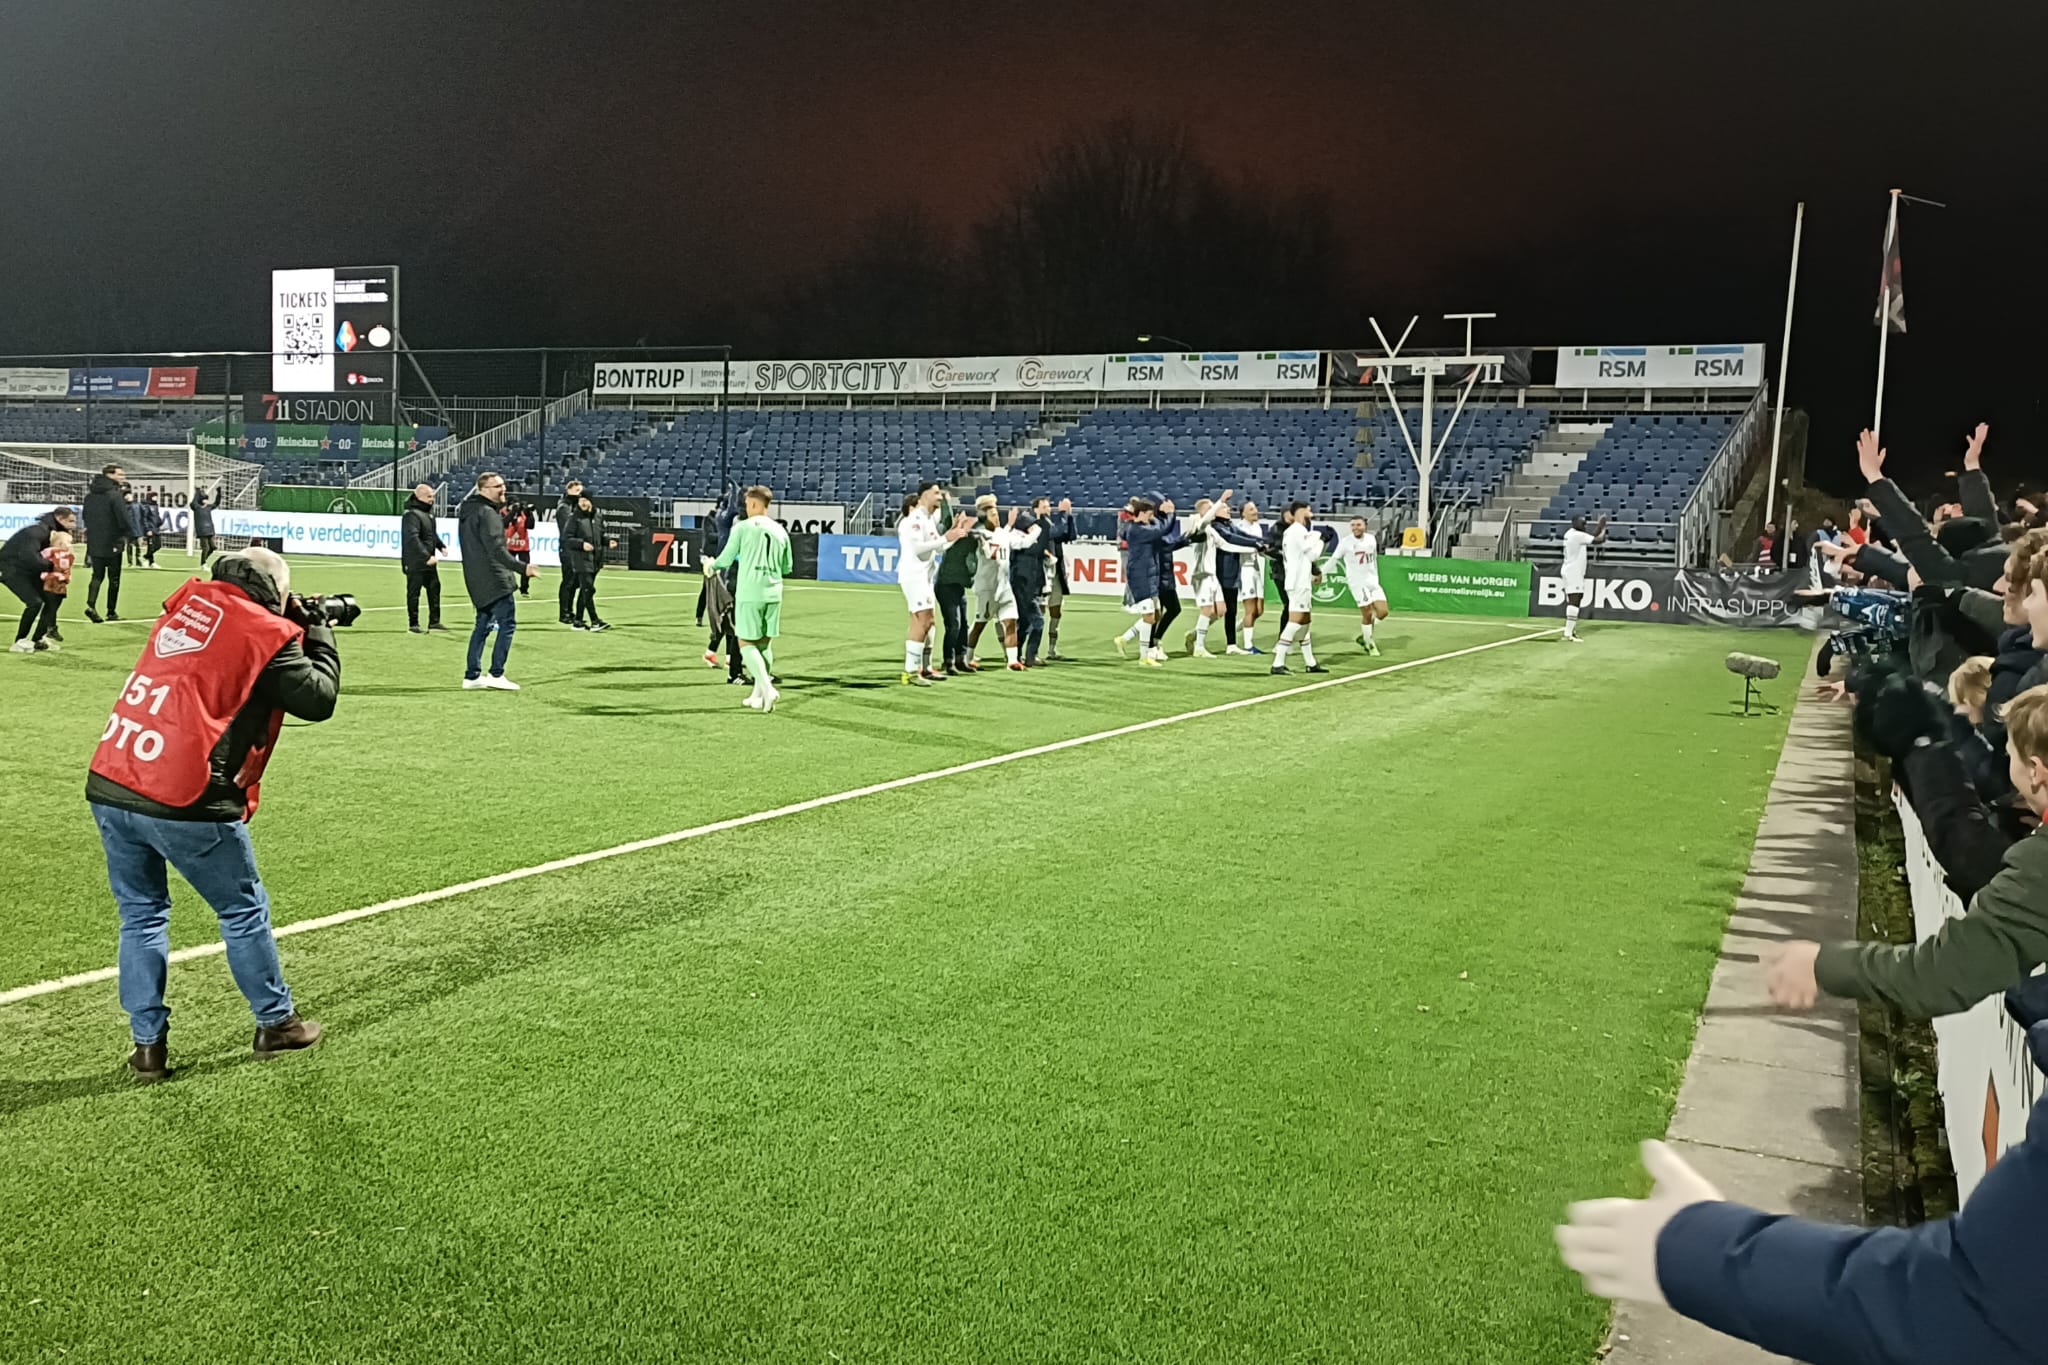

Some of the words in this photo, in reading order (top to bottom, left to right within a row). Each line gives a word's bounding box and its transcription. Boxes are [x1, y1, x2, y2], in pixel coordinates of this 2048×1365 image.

[280, 292, 328, 308] TICKETS
[701, 368, 736, 380] Innovte
[1127, 365, 1164, 381] RSM
[1201, 364, 1239, 380] RSM
[1277, 363, 1317, 379] RSM
[1599, 360, 1647, 378] RSM
[1694, 358, 1744, 376] RSM
[596, 369, 684, 388] BONTRUP
[754, 361, 907, 391] SPORTCITY
[720, 380, 746, 391] nture
[294, 399, 374, 422] STADION
[197, 434, 236, 447] Heinekn
[276, 434, 319, 448] Heineken
[361, 436, 405, 449] Heinekn
[309, 525, 400, 550] verdediging
[652, 532, 691, 568] 711
[841, 545, 900, 572] TAT
[1408, 572, 1448, 583] VISSERS
[1450, 574, 1470, 585] VAN
[1472, 576, 1518, 588] MORGEN
[100, 712, 166, 762] OTO
